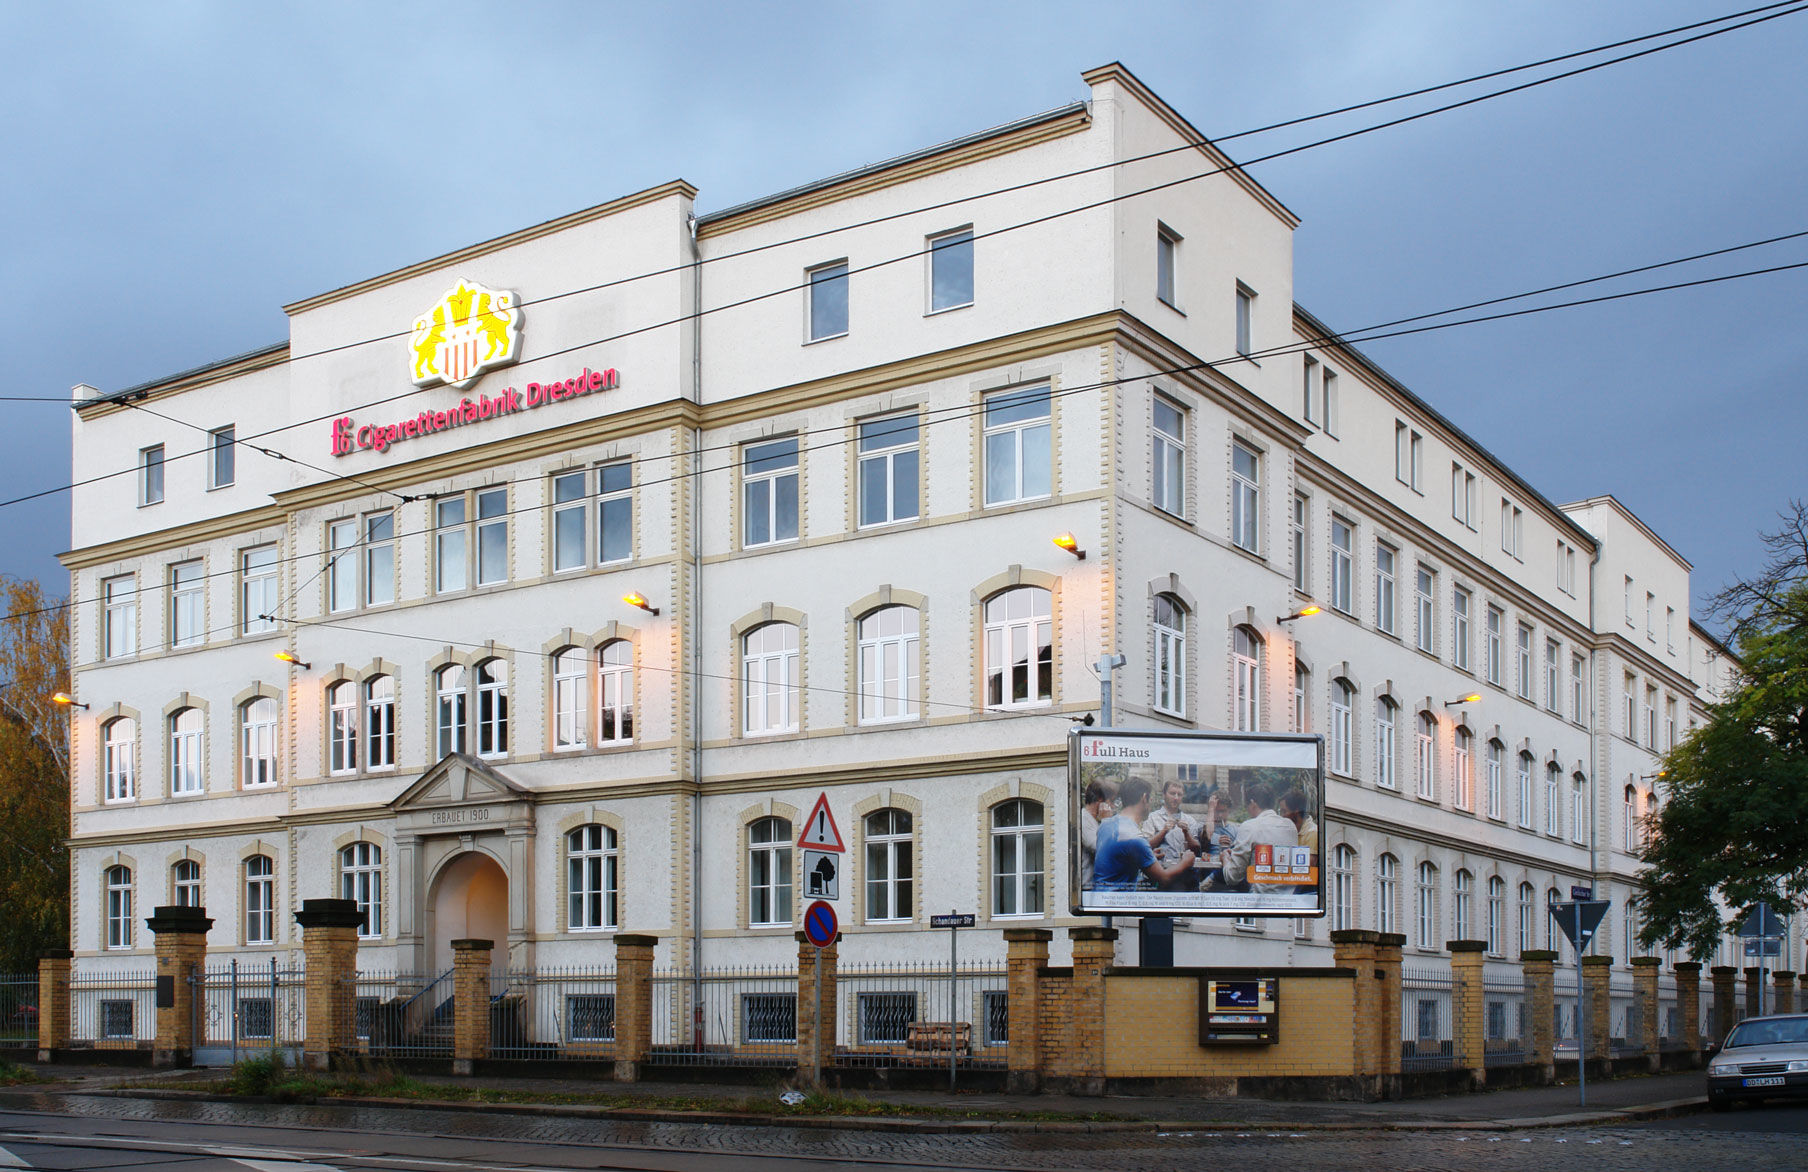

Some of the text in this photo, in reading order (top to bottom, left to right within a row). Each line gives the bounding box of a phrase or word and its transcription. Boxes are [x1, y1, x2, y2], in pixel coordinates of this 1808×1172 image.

[357, 387, 520, 452] Cigarettenfabrik
[526, 368, 617, 407] Dresden
[1118, 747, 1150, 758] Haus
[432, 809, 489, 824] ERBAUET 1900
[932, 916, 962, 925] Schandauer
